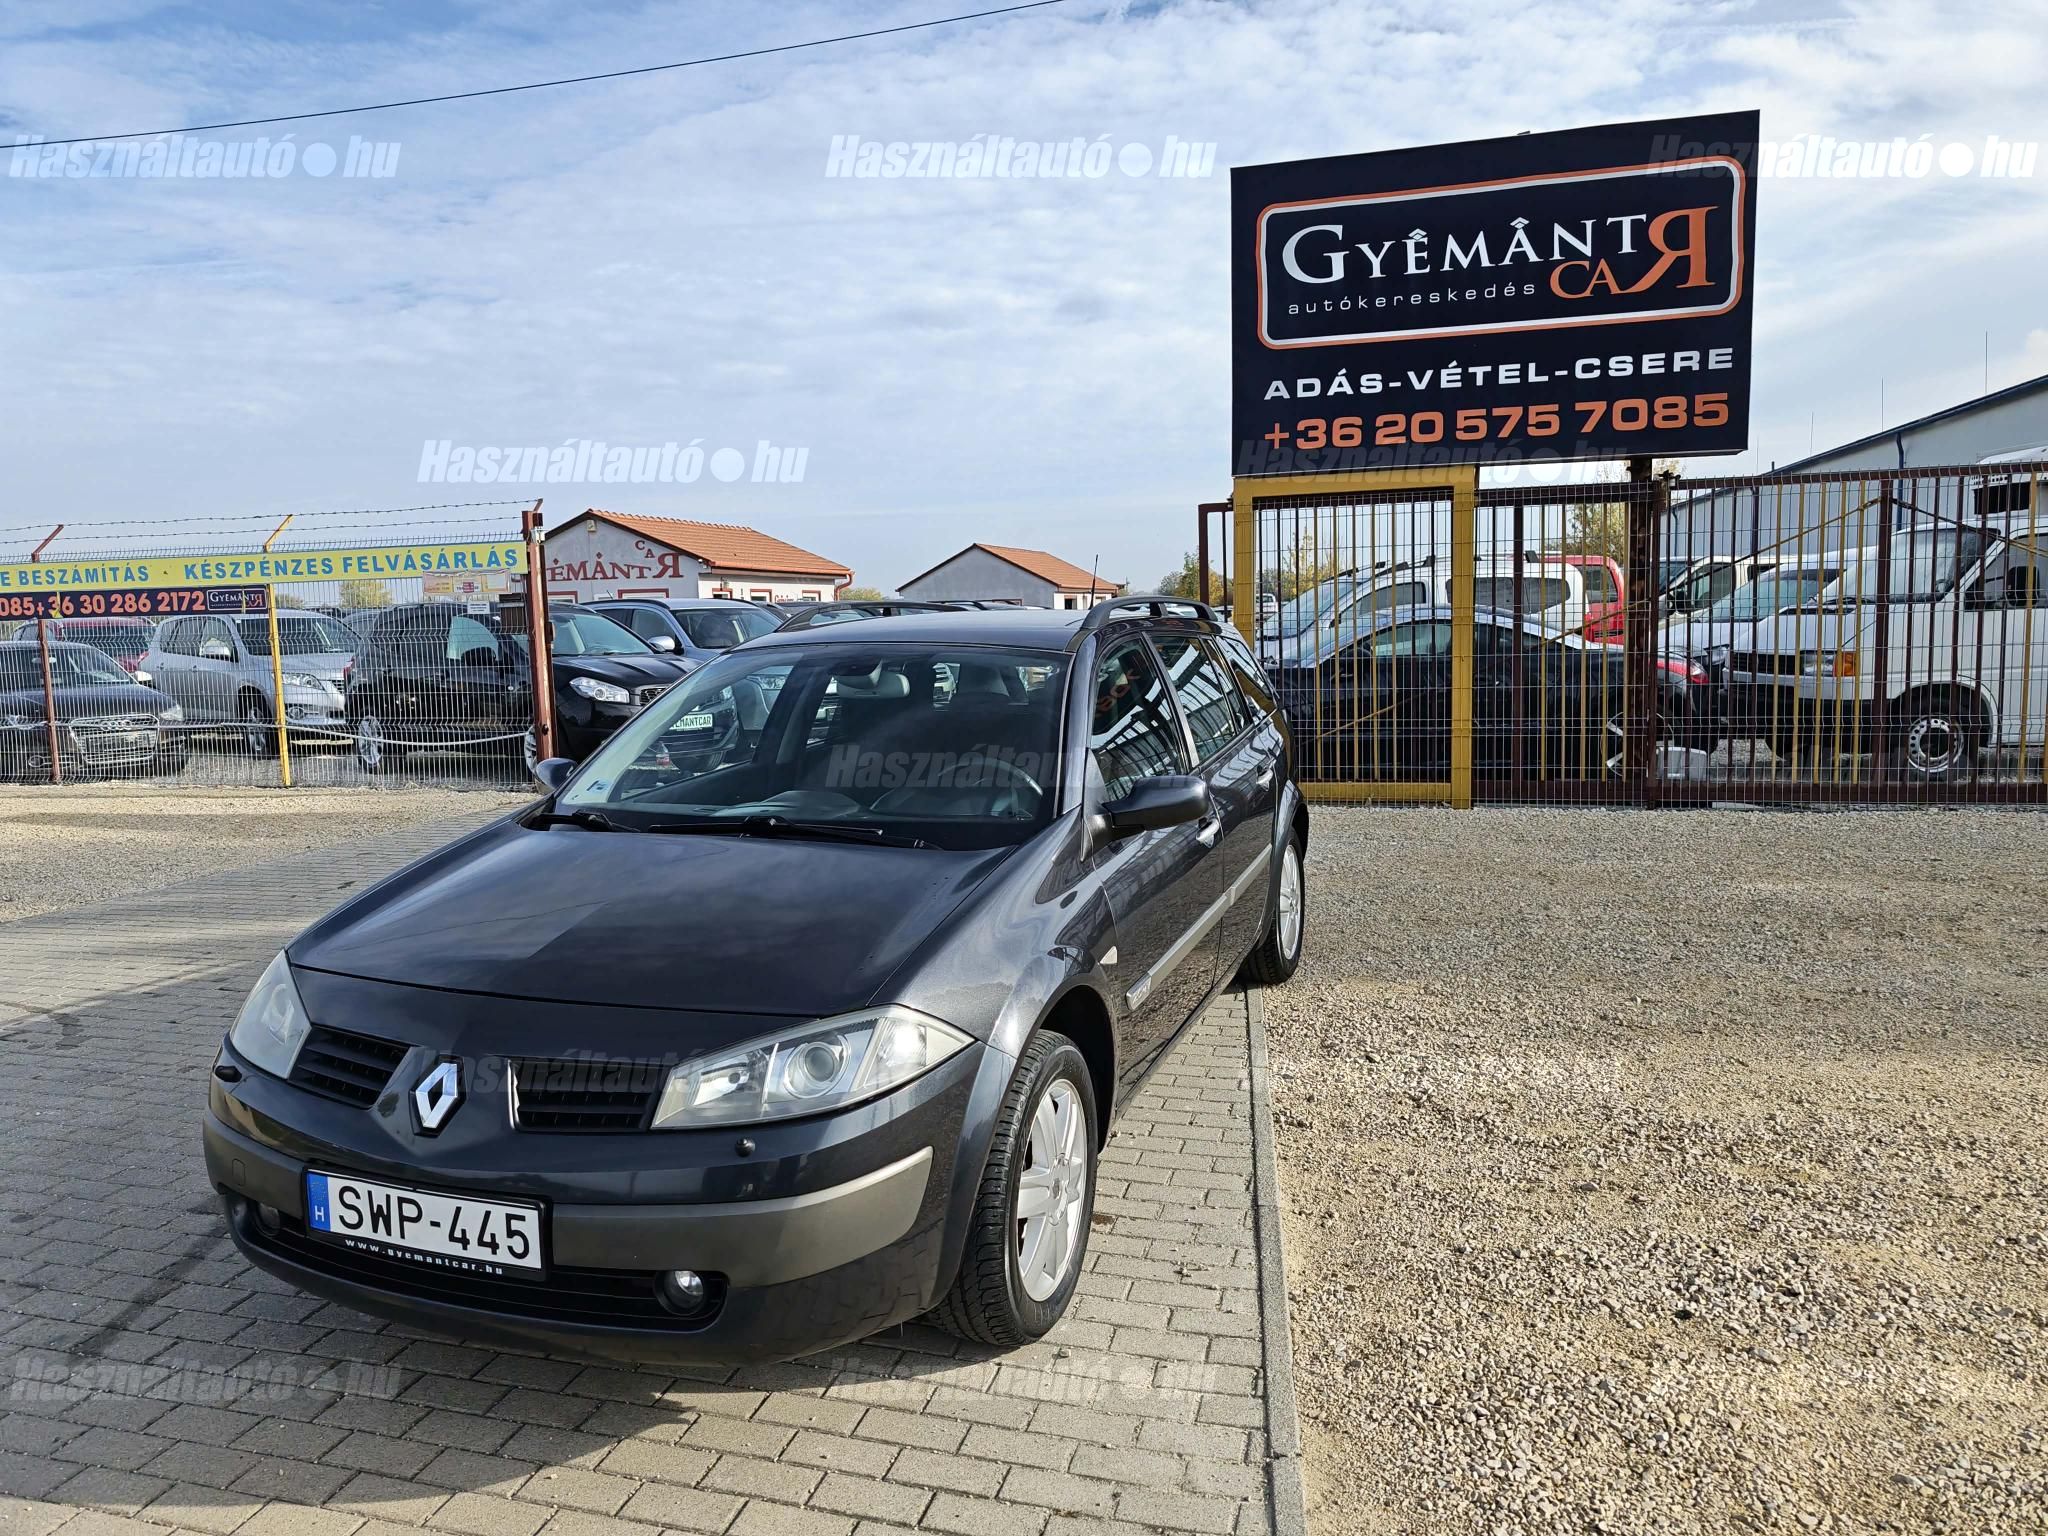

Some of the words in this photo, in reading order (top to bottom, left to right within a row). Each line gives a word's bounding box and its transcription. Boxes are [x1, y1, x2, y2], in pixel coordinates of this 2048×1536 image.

[1288, 281, 1536, 315] autókereskedés
[1263, 347, 1734, 400] ADÁS-VÉTEL-CSERE
[1264, 416, 1362, 450] +36
[1375, 411, 1444, 446] 20
[1455, 404, 1561, 441] 575
[1575, 393, 1729, 433] 7085
[18, 562, 150, 586] BESZÁMÍTÁS
[184, 556, 334, 581] KÉSZPÉNZES
[343, 546, 518, 573] FELVÁSÁRLÁS
[79, 594, 105, 614] 30
[110, 592, 151, 613] 286
[157, 591, 206, 612] 2172
[314, 1205, 325, 1223] H
[338, 1185, 530, 1260] SWP-445
[344, 1239, 504, 1275] www.gyemantcar.hu
